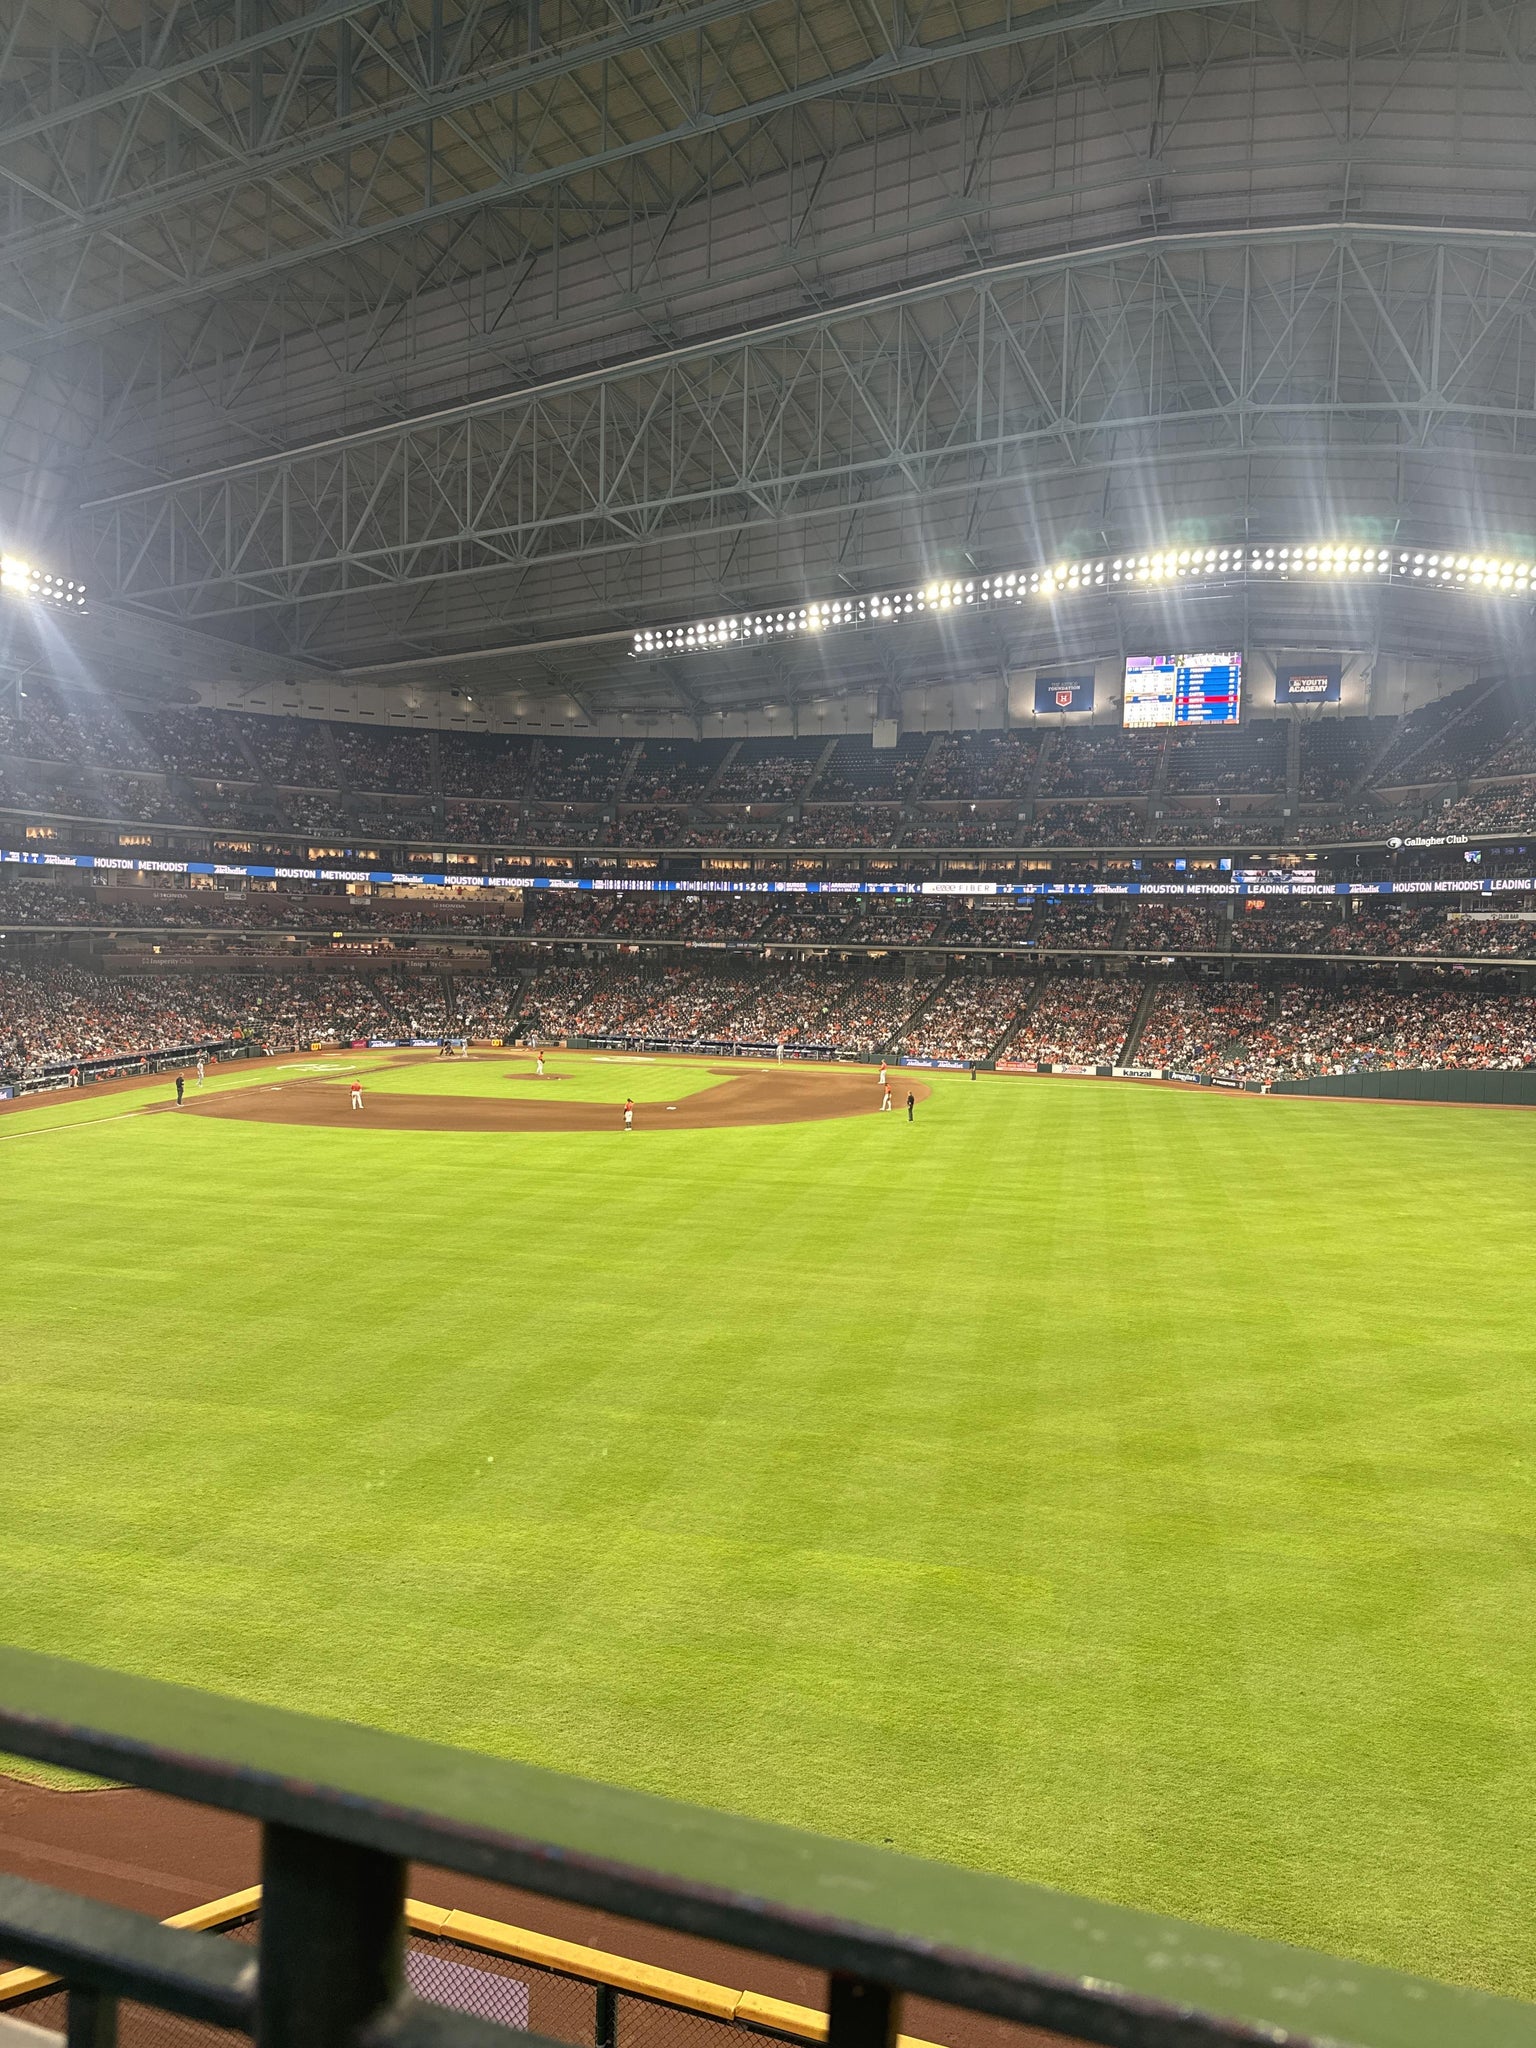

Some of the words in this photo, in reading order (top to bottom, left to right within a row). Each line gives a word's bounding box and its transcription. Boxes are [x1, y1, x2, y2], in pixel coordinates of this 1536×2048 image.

[1289, 685, 1327, 693] ACADEMY
[1404, 837, 1444, 847] Gallagher
[1446, 835, 1468, 844] Club
[94, 858, 133, 869] HOUSTON
[139, 861, 188, 872] METHODIST
[275, 868, 315, 879] HOUSTON
[321, 871, 370, 882] METHODIST
[445, 876, 483, 886] HOUSTON
[489, 878, 534, 888] METHODIST
[1392, 882, 1432, 892] HOUSTON
[1434, 880, 1484, 891] METHODIST
[1490, 879, 1531, 890] LEADING
[908, 884, 916, 893] K
[1140, 884, 1183, 894] HOUSTON
[1186, 884, 1240, 894] METHODIST
[1247, 884, 1289, 894] LEADING
[1292, 884, 1335, 894] MEDICINE
